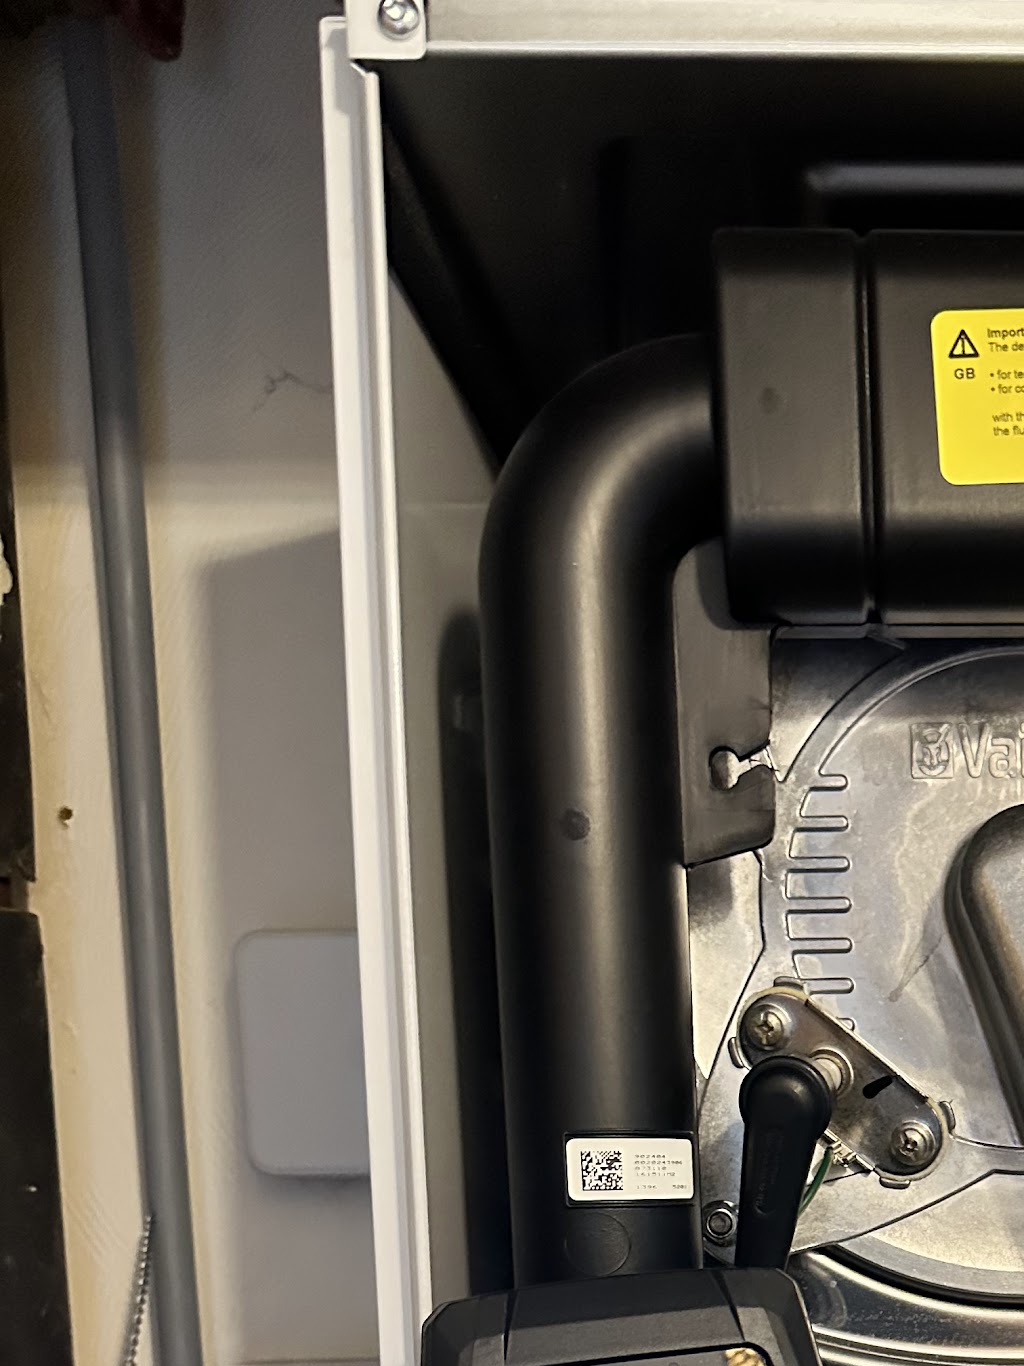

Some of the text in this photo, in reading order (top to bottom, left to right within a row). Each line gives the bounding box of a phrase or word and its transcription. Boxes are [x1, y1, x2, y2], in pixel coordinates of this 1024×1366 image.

[988, 341, 1008, 352] The
[953, 367, 976, 381] GB
[996, 369, 1012, 380] for
[997, 383, 1012, 394] for
[991, 412, 1013, 423] with
[993, 426, 1010, 437] the
